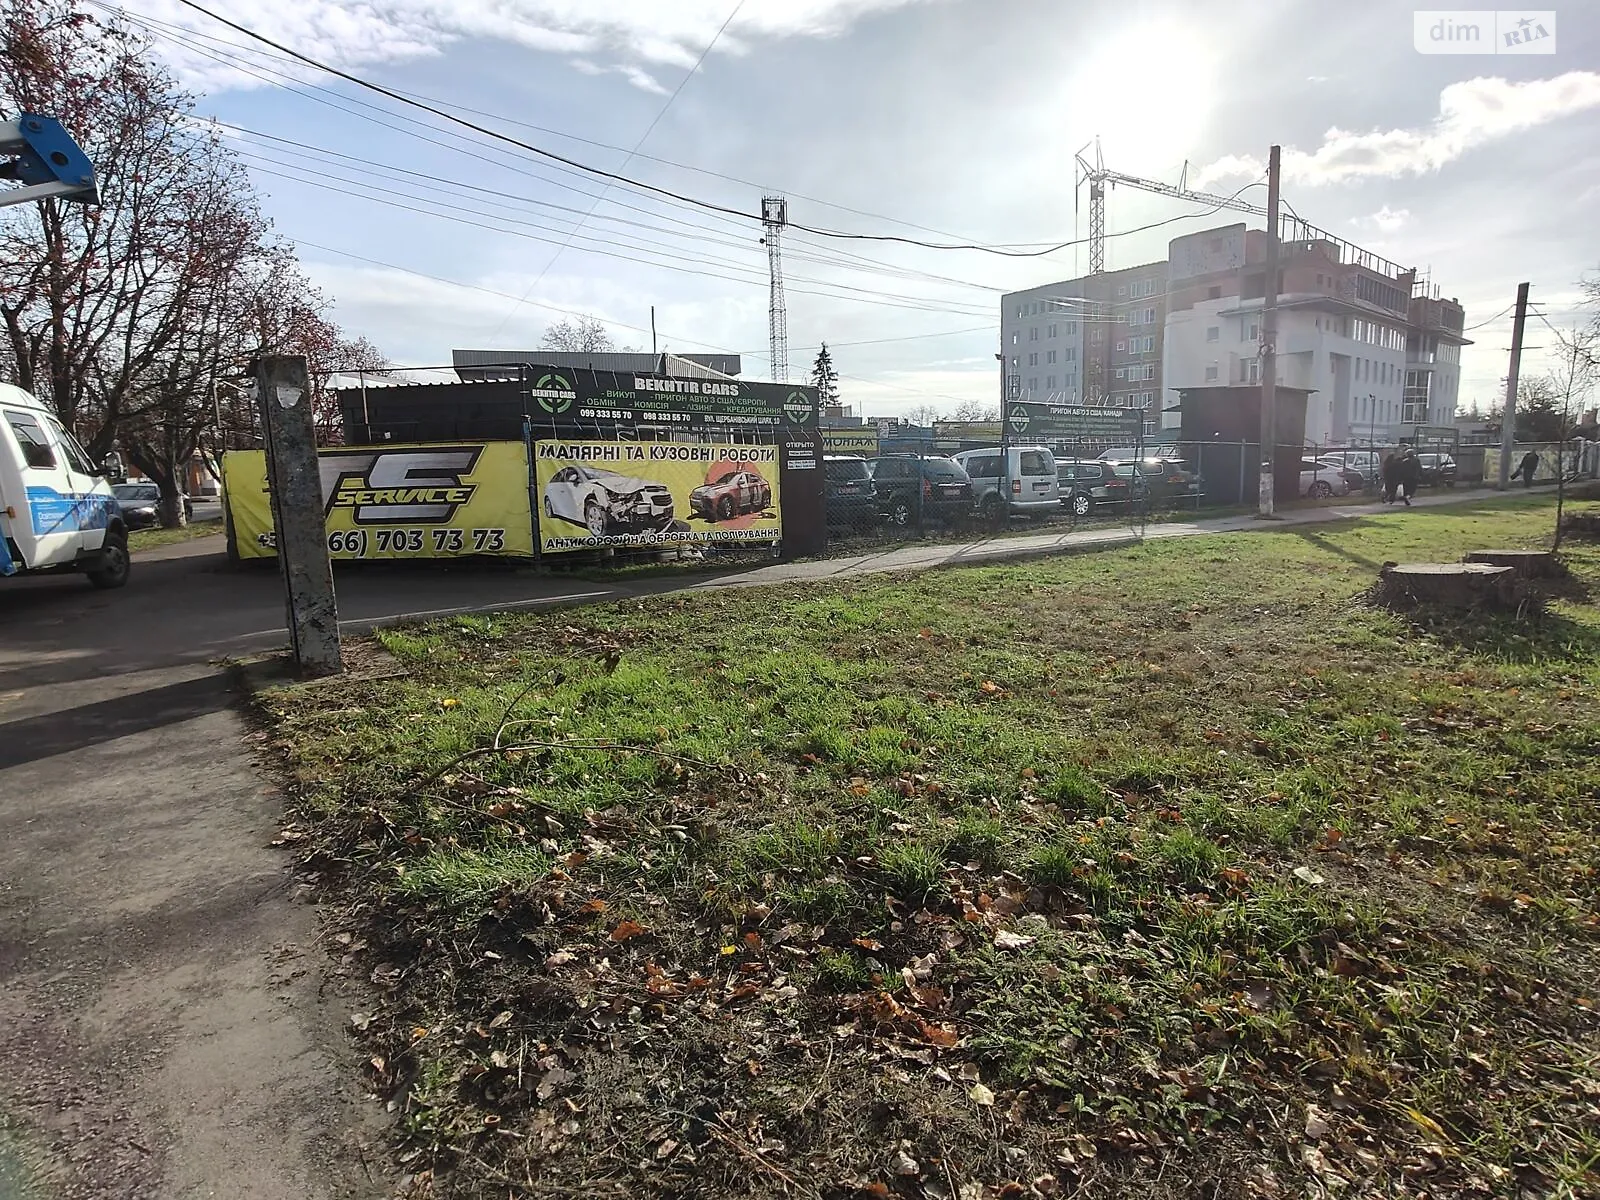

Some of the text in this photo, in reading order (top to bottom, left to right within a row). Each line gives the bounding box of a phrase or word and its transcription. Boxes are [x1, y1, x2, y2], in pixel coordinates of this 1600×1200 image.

[634, 377, 739, 396] BEKHTIR CARS
[606, 390, 636, 399] ВИКУП
[655, 393, 687, 402] ПРИГОН
[690, 395, 708, 403] АВТО
[580, 409, 595, 418] 099
[596, 410, 611, 418] 333
[612, 411, 621, 419] 55
[586, 398, 616, 406] ОБМІН
[634, 401, 669, 410] КОМІСІЯ
[726, 405, 782, 414] КРЕДИТУВАННЯ
[657, 413, 671, 421] 333
[672, 413, 681, 421] 55
[539, 443, 776, 463] МАЛЯРНІ ТА КУЗОВНІ РОБОТИ
[334, 487, 473, 505] SERVICE
[328, 529, 368, 558] 66)
[376, 529, 423, 552] 703
[432, 529, 464, 551] 73
[471, 529, 505, 551] 73
[648, 531, 699, 545] ОБРОБКА
[700, 531, 714, 542] ТА
[715, 527, 780, 542] ПОЛІРУВАННЯ
